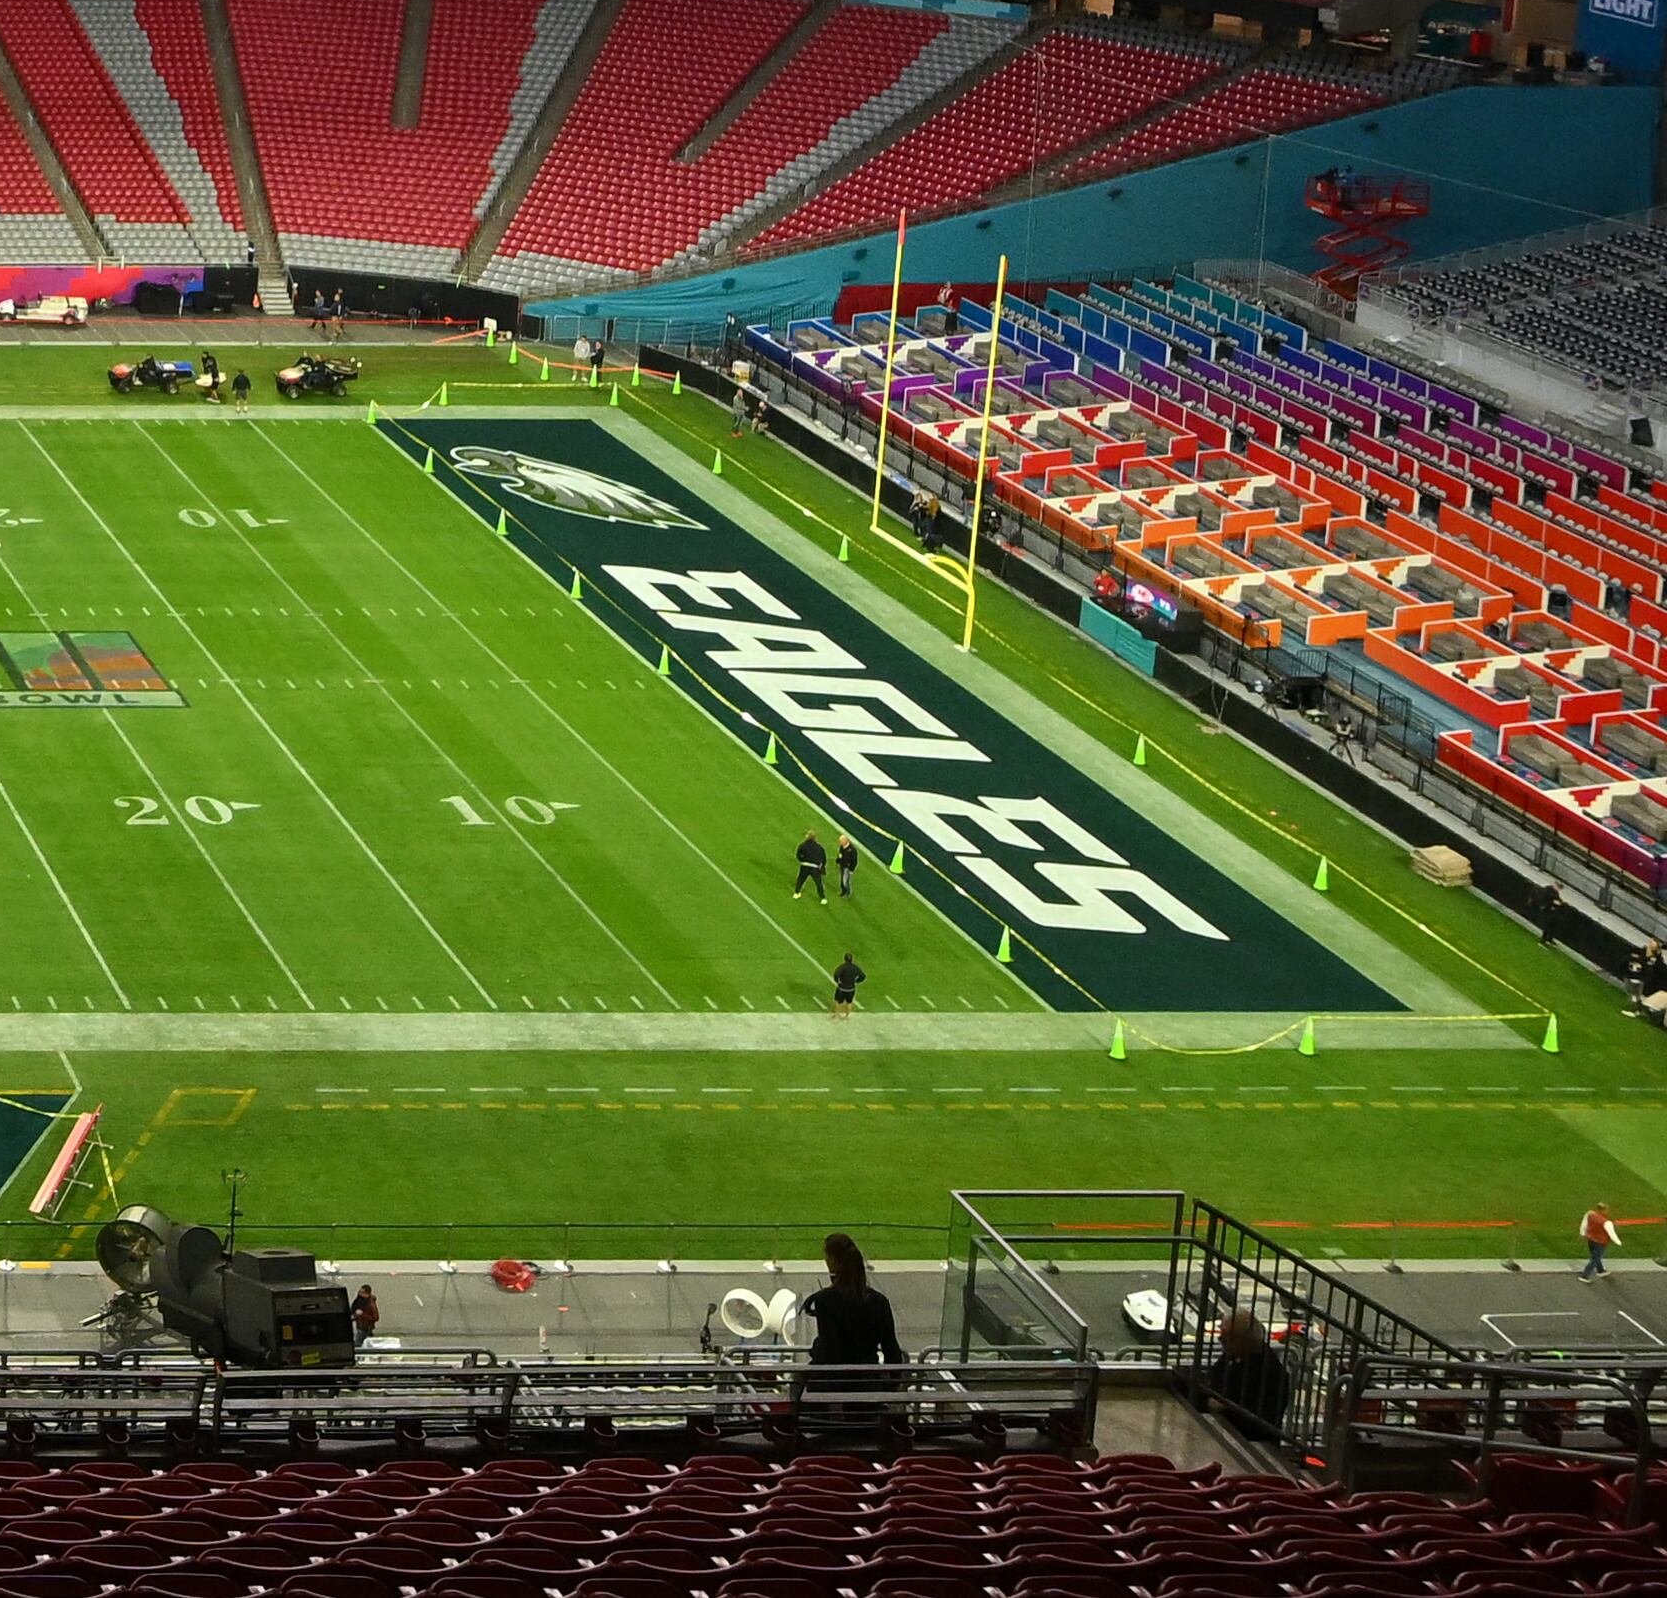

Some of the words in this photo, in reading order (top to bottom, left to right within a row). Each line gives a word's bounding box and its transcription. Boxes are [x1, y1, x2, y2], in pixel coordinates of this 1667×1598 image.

[601, 563, 1232, 942] EAGLES
[114, 795, 234, 826] 20
[440, 795, 557, 827] 10
